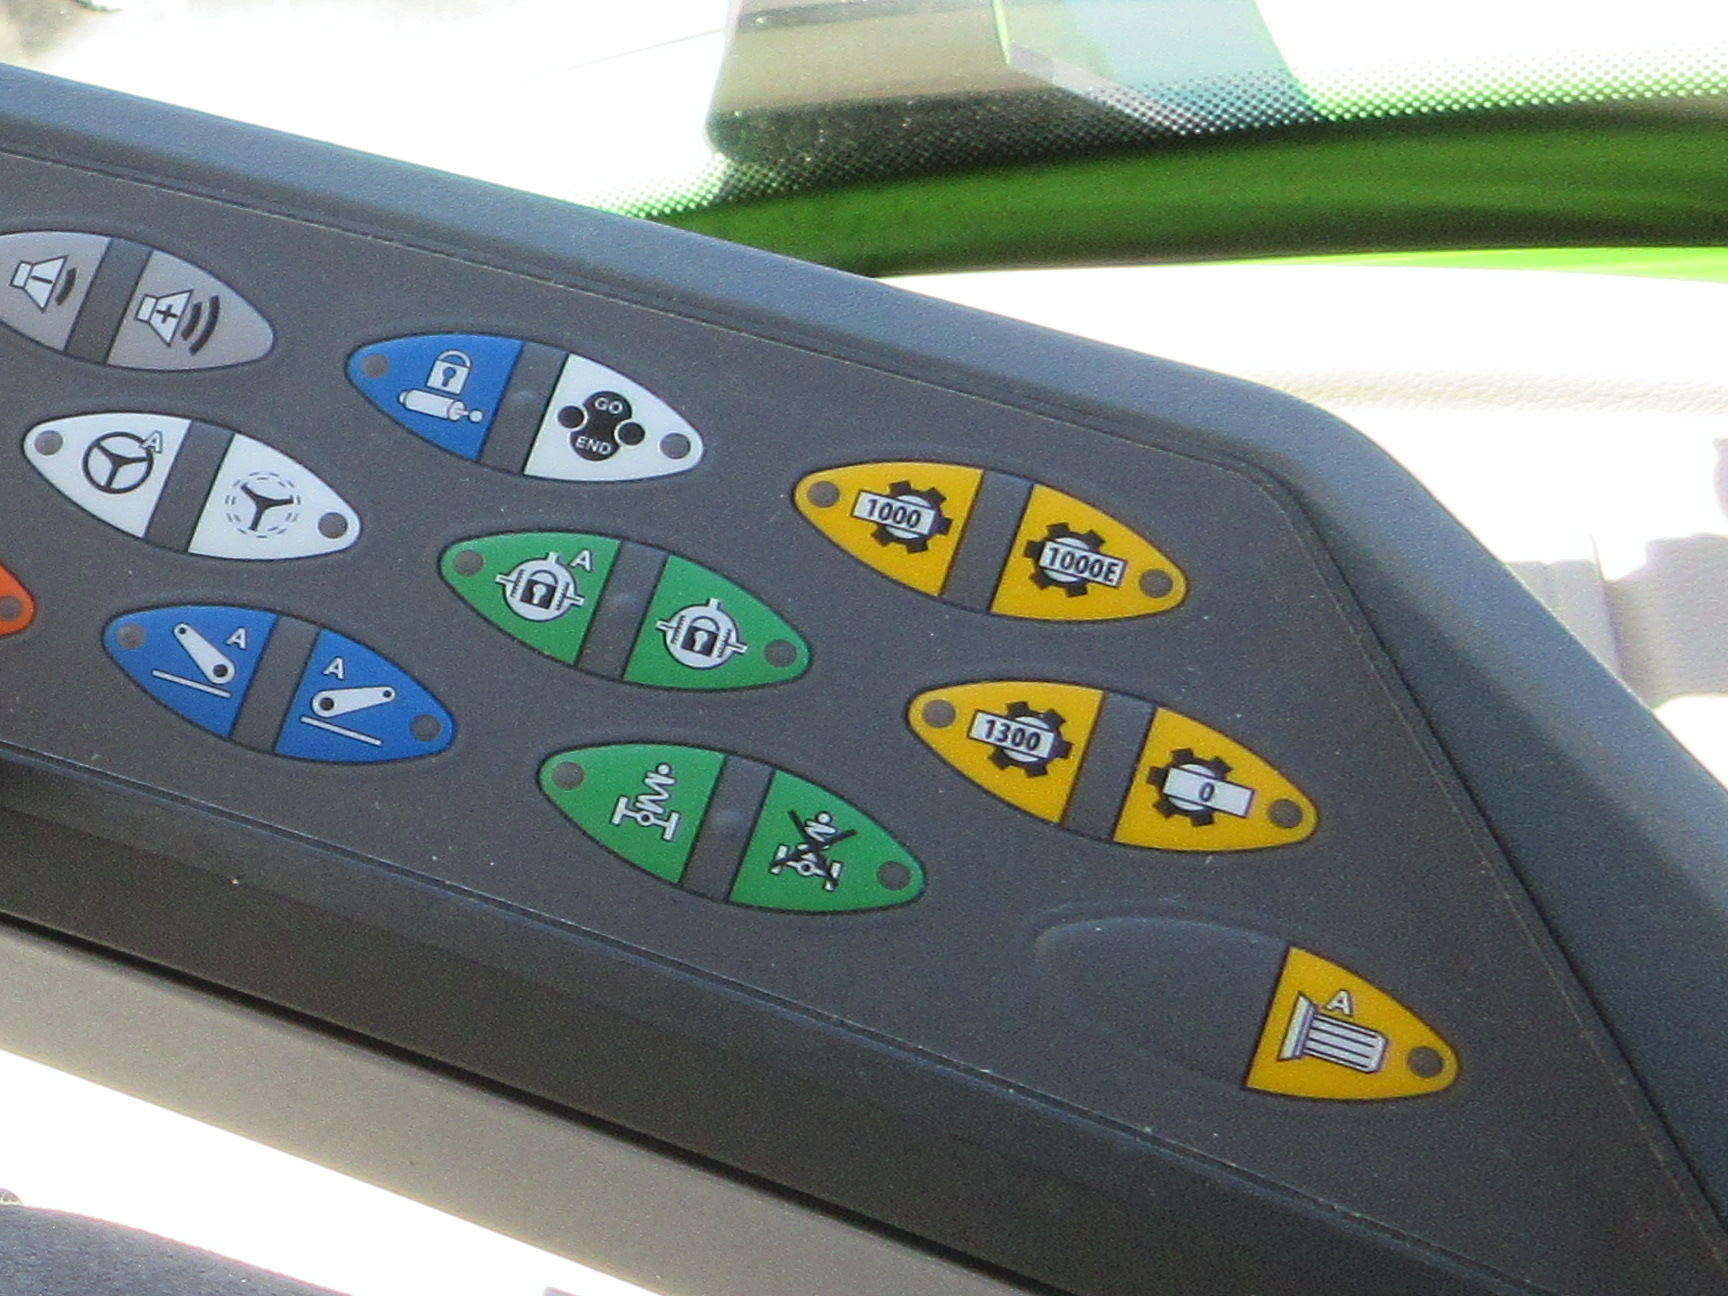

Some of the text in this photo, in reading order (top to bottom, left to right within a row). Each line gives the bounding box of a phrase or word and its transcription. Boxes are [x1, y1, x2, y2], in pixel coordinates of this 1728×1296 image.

[594, 396, 623, 415] GO
[139, 429, 163, 454] A
[575, 435, 611, 455] END
[864, 498, 921, 529] 1000
[570, 549, 594, 571] A
[1046, 546, 1119, 584] 1000E
[226, 628, 248, 650] A
[323, 656, 345, 679] A
[984, 718, 1041, 752] 1300
[1199, 781, 1215, 803] 0
[1326, 989, 1353, 1016] A
